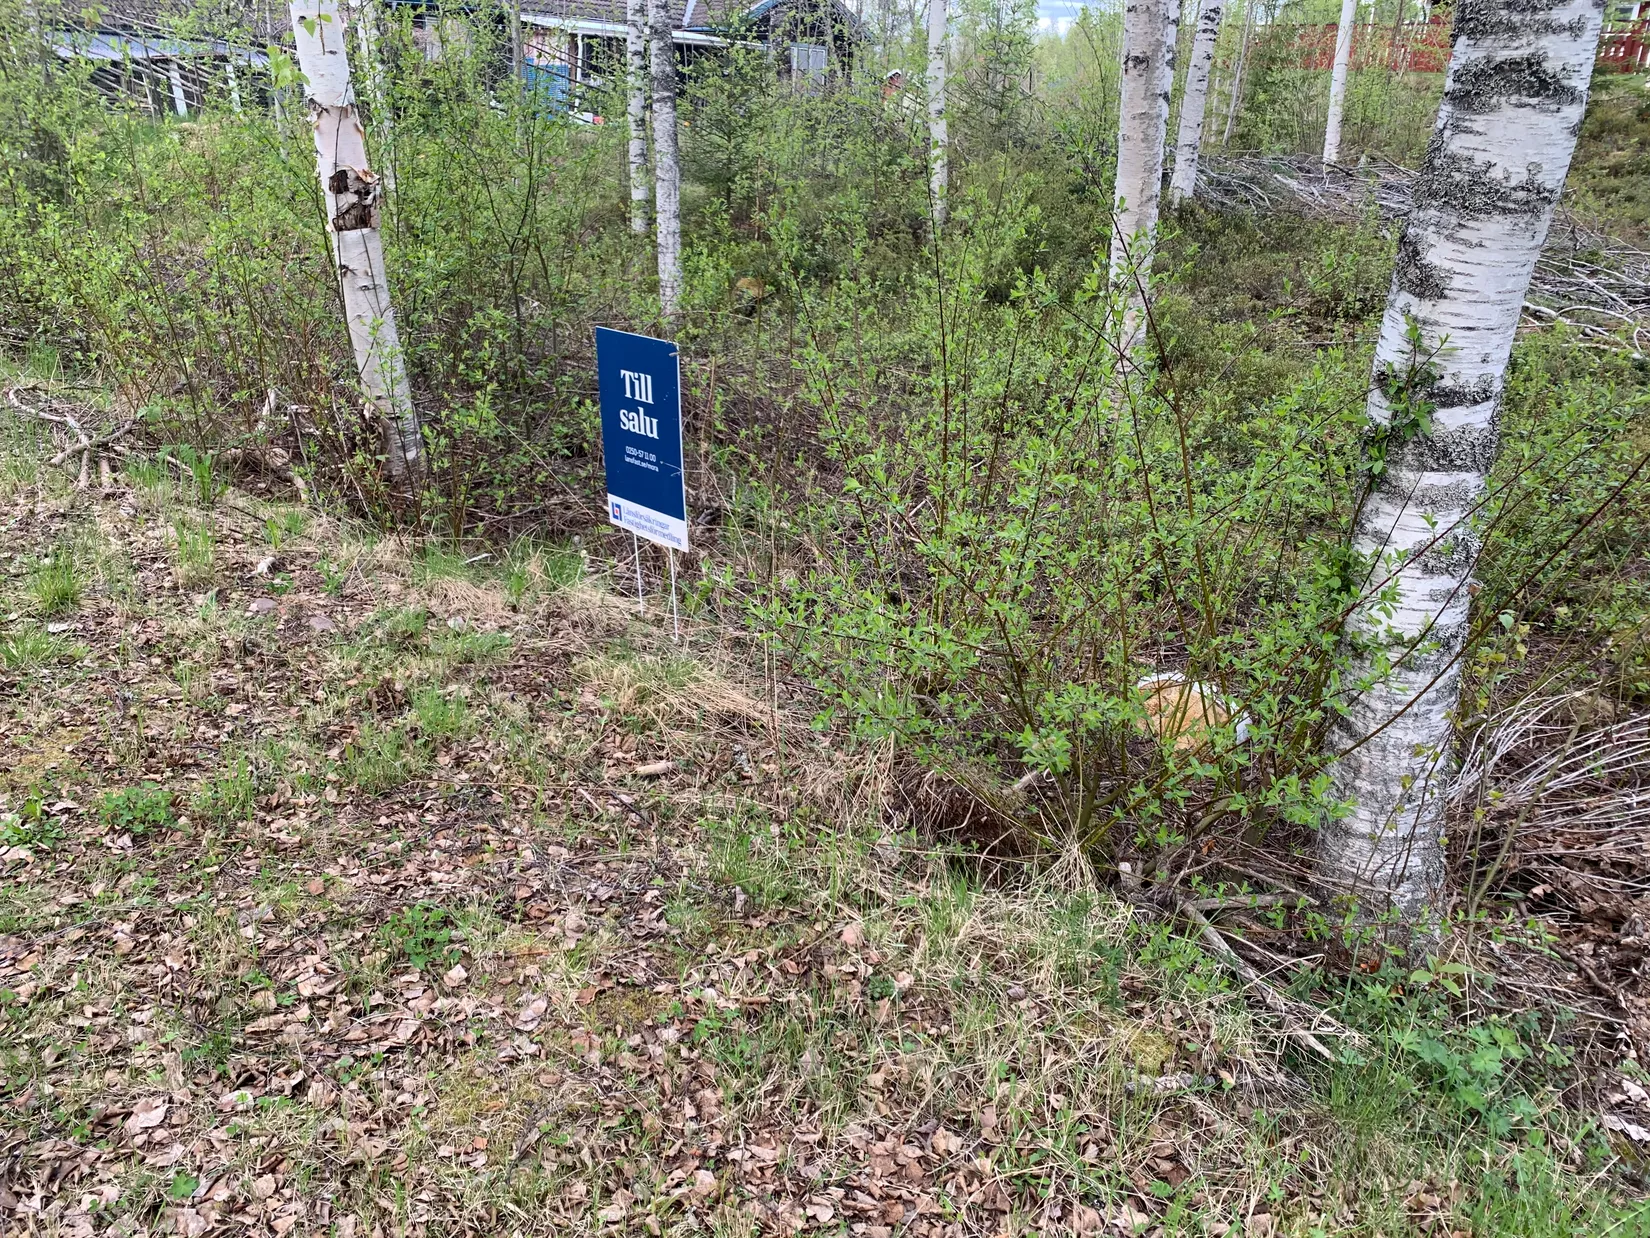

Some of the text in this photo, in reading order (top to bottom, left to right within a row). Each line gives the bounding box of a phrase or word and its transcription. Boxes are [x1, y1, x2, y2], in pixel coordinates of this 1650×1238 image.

[620, 369, 654, 405] Till
[619, 406, 659, 440] salu
[625, 445, 644, 458] 0250-57
